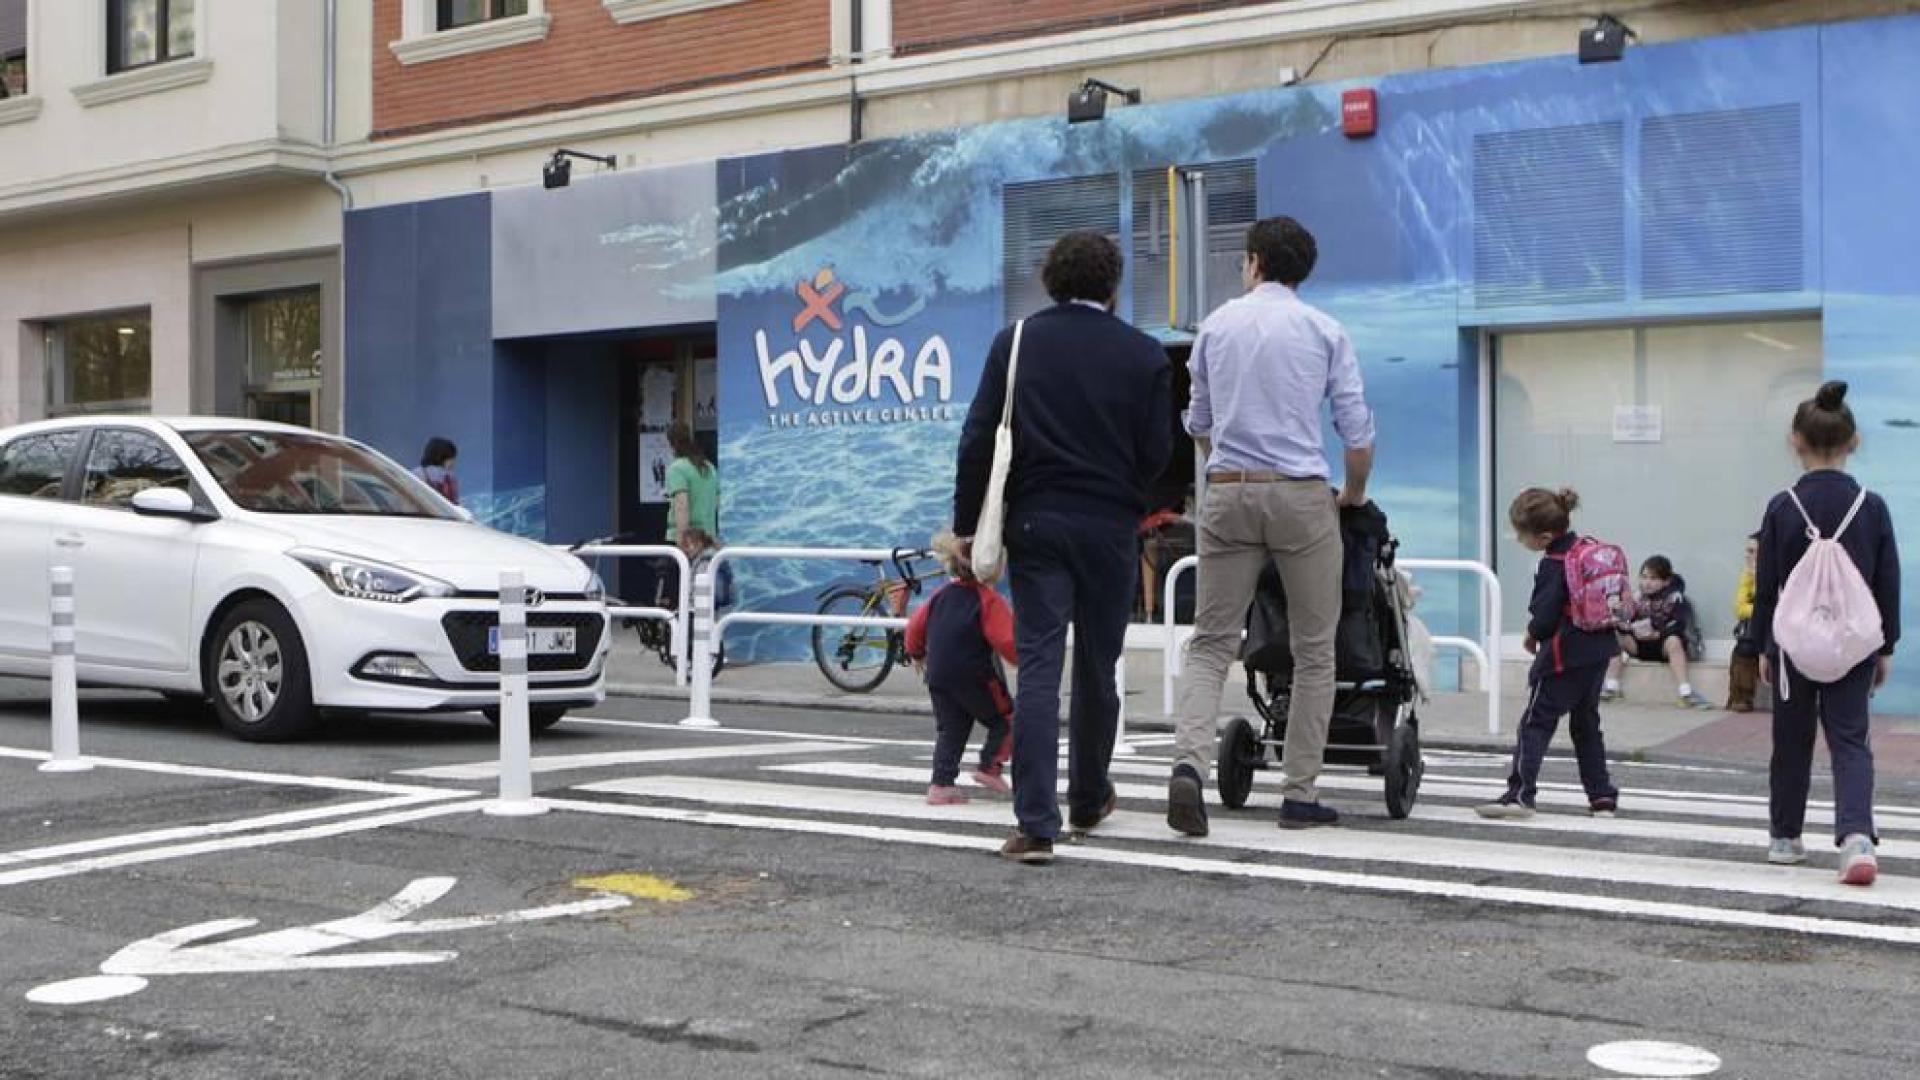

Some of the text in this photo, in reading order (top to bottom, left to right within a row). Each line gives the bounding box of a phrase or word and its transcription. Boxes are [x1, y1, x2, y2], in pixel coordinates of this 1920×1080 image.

[769, 406, 953, 426] THE ACTIVE CENTER
